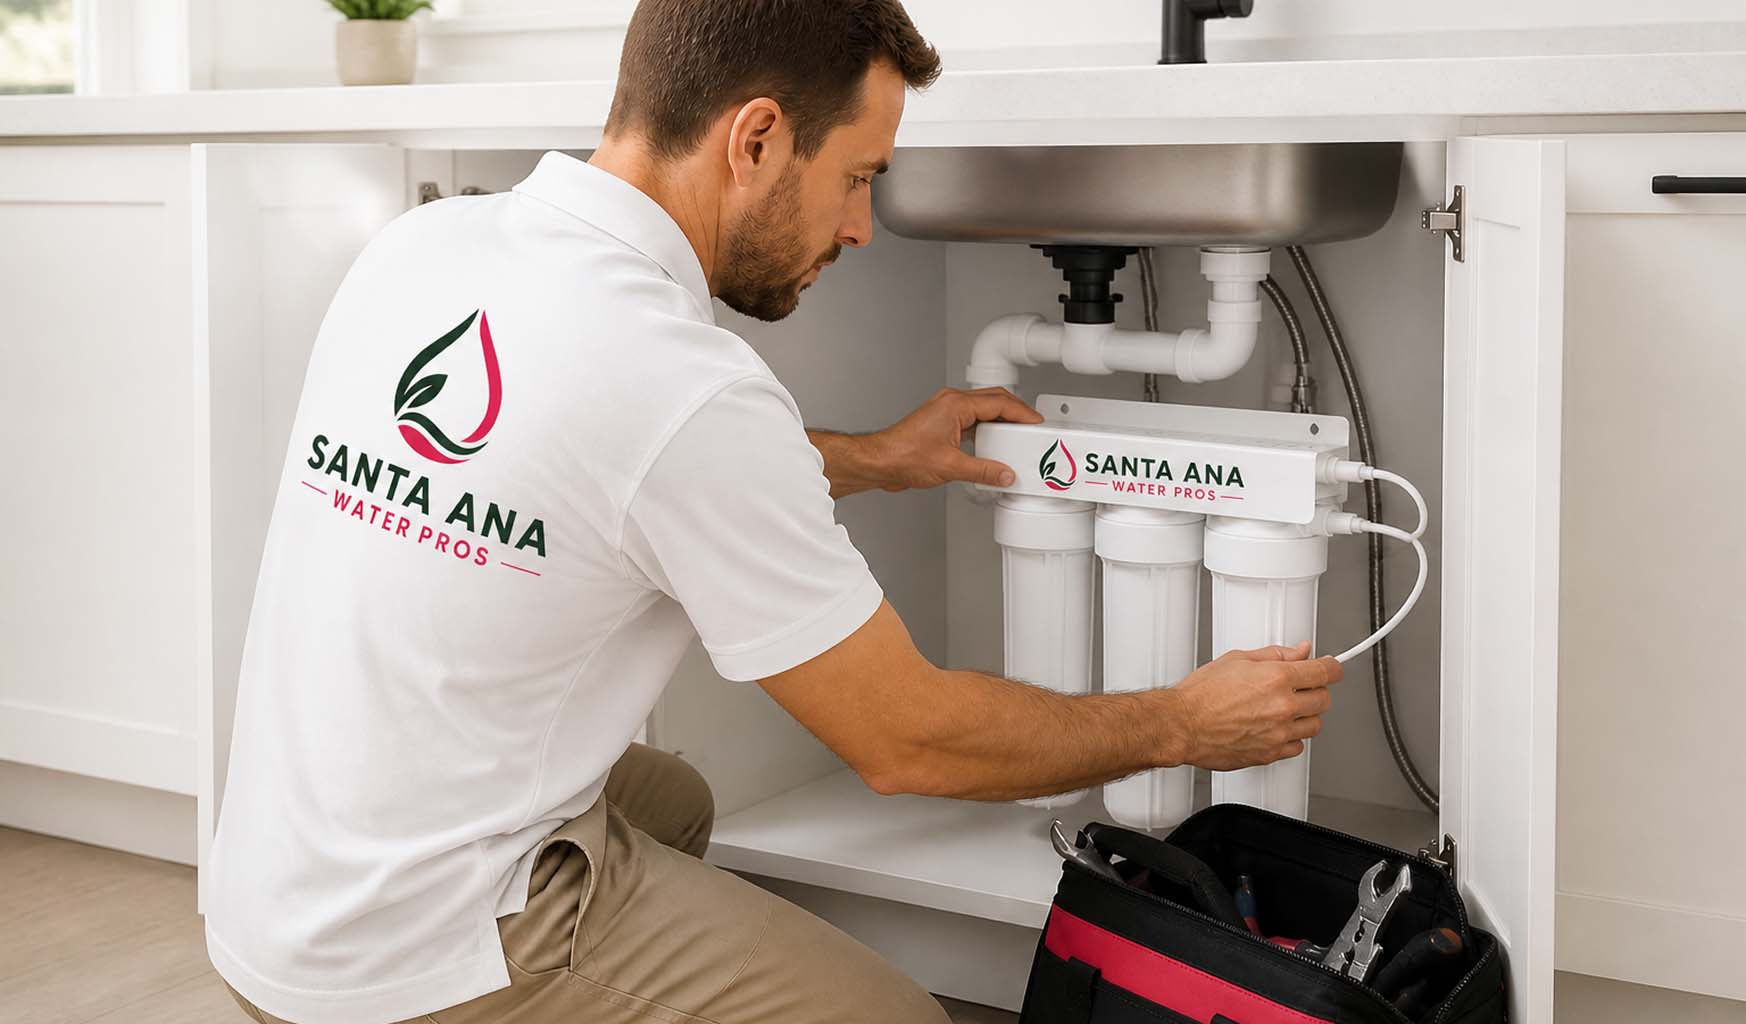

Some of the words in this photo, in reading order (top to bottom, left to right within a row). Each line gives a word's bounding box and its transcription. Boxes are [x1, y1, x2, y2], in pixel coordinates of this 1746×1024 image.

[307, 434, 430, 515] SANTA
[445, 492, 546, 558] ANA
[1085, 453, 1173, 481] SANTA
[1183, 462, 1245, 488] ANA
[1112, 480, 1166, 497] WATER
[1174, 486, 1216, 501] PROS
[333, 489, 411, 537] WATER
[418, 525, 489, 566] PROS
